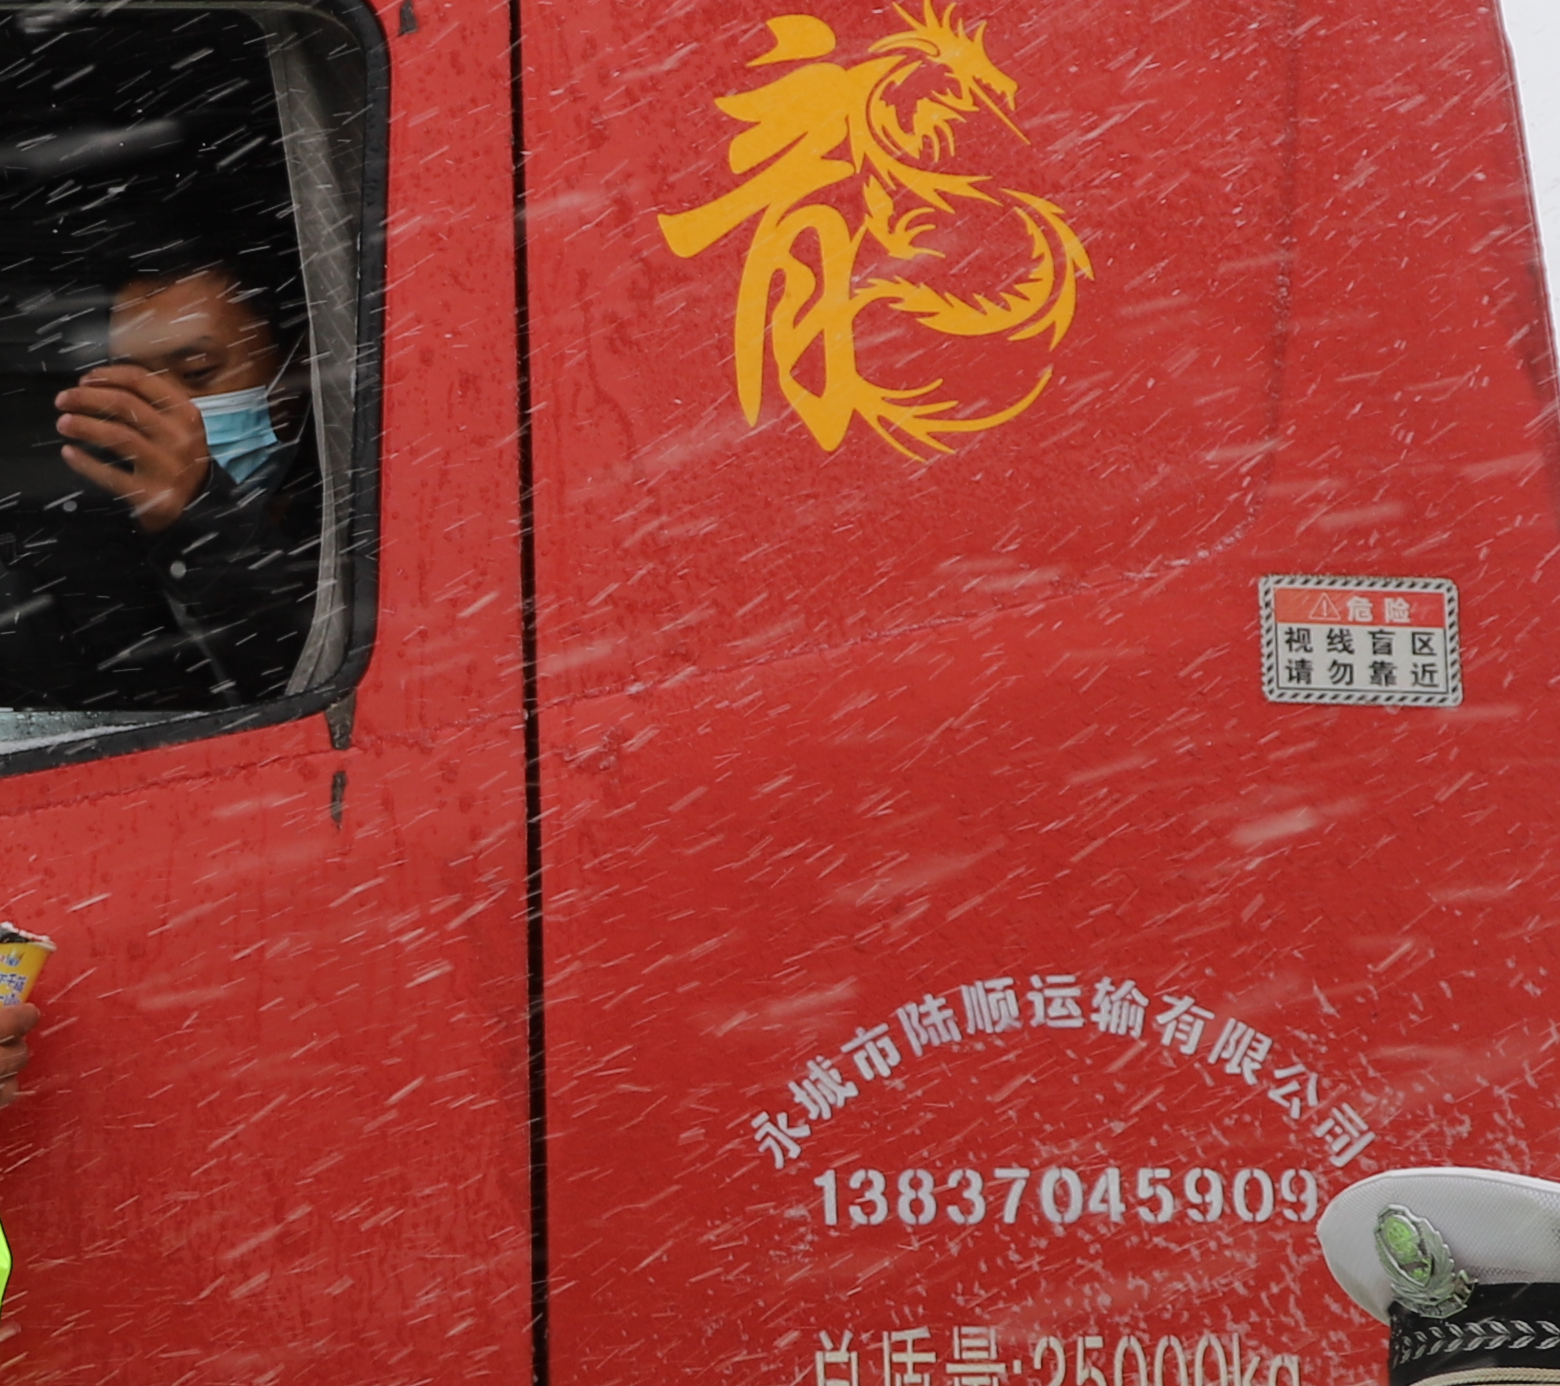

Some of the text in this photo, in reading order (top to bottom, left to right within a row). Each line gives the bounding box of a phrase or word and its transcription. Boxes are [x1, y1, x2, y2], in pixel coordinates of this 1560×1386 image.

[1346, 595, 1411, 623] 危险
[1285, 627, 1437, 657] 视线盲区
[1285, 659, 1439, 688] 请勿靠近
[751, 974, 1376, 1169] 永城市陆顺运输有限公司
[814, 1167, 1319, 1226] 13837045909
